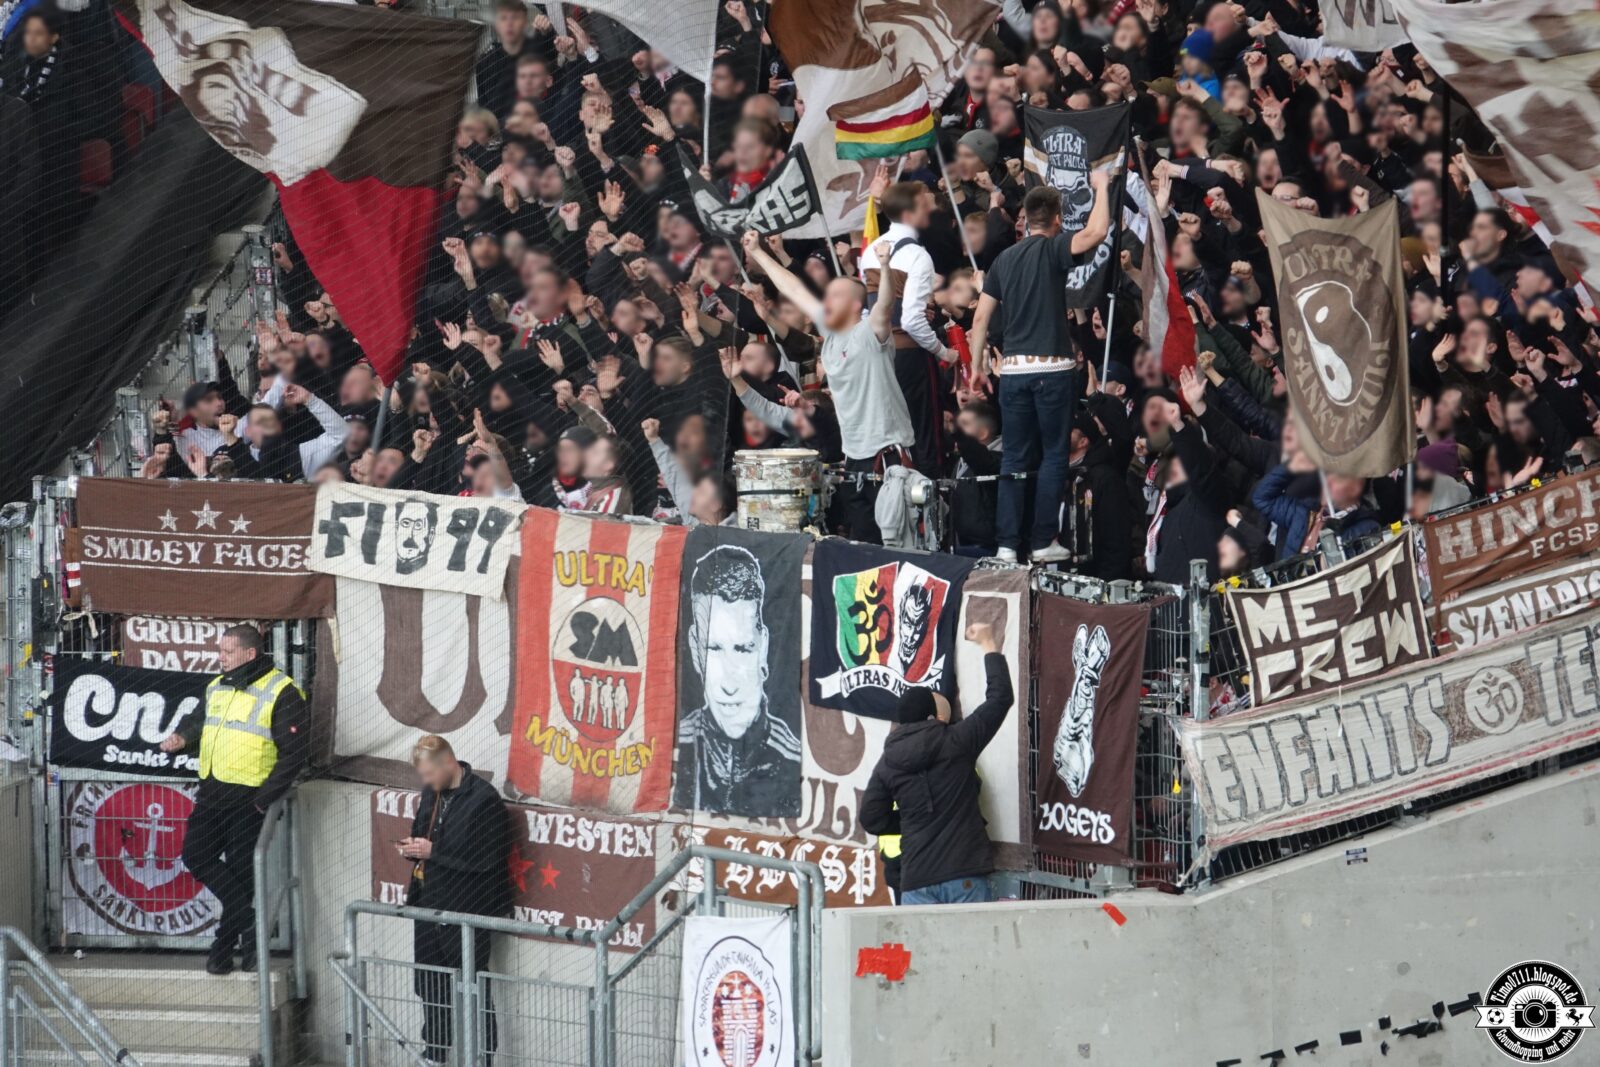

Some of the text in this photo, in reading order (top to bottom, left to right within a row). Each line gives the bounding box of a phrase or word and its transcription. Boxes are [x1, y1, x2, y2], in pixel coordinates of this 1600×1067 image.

[82, 534, 206, 566] SMILEY
[1530, 522, 1600, 559] FCSP
[1241, 541, 1405, 649] METT
[1256, 602, 1421, 704] CREW
[103, 744, 170, 768] Sankt
[524, 714, 656, 778] MÜNCHEN
[1195, 671, 1455, 825] ENFANTS
[525, 809, 656, 858] WESTEN
[1039, 802, 1116, 845] BOGEYS
[93, 884, 213, 931] SANKT PAULI
